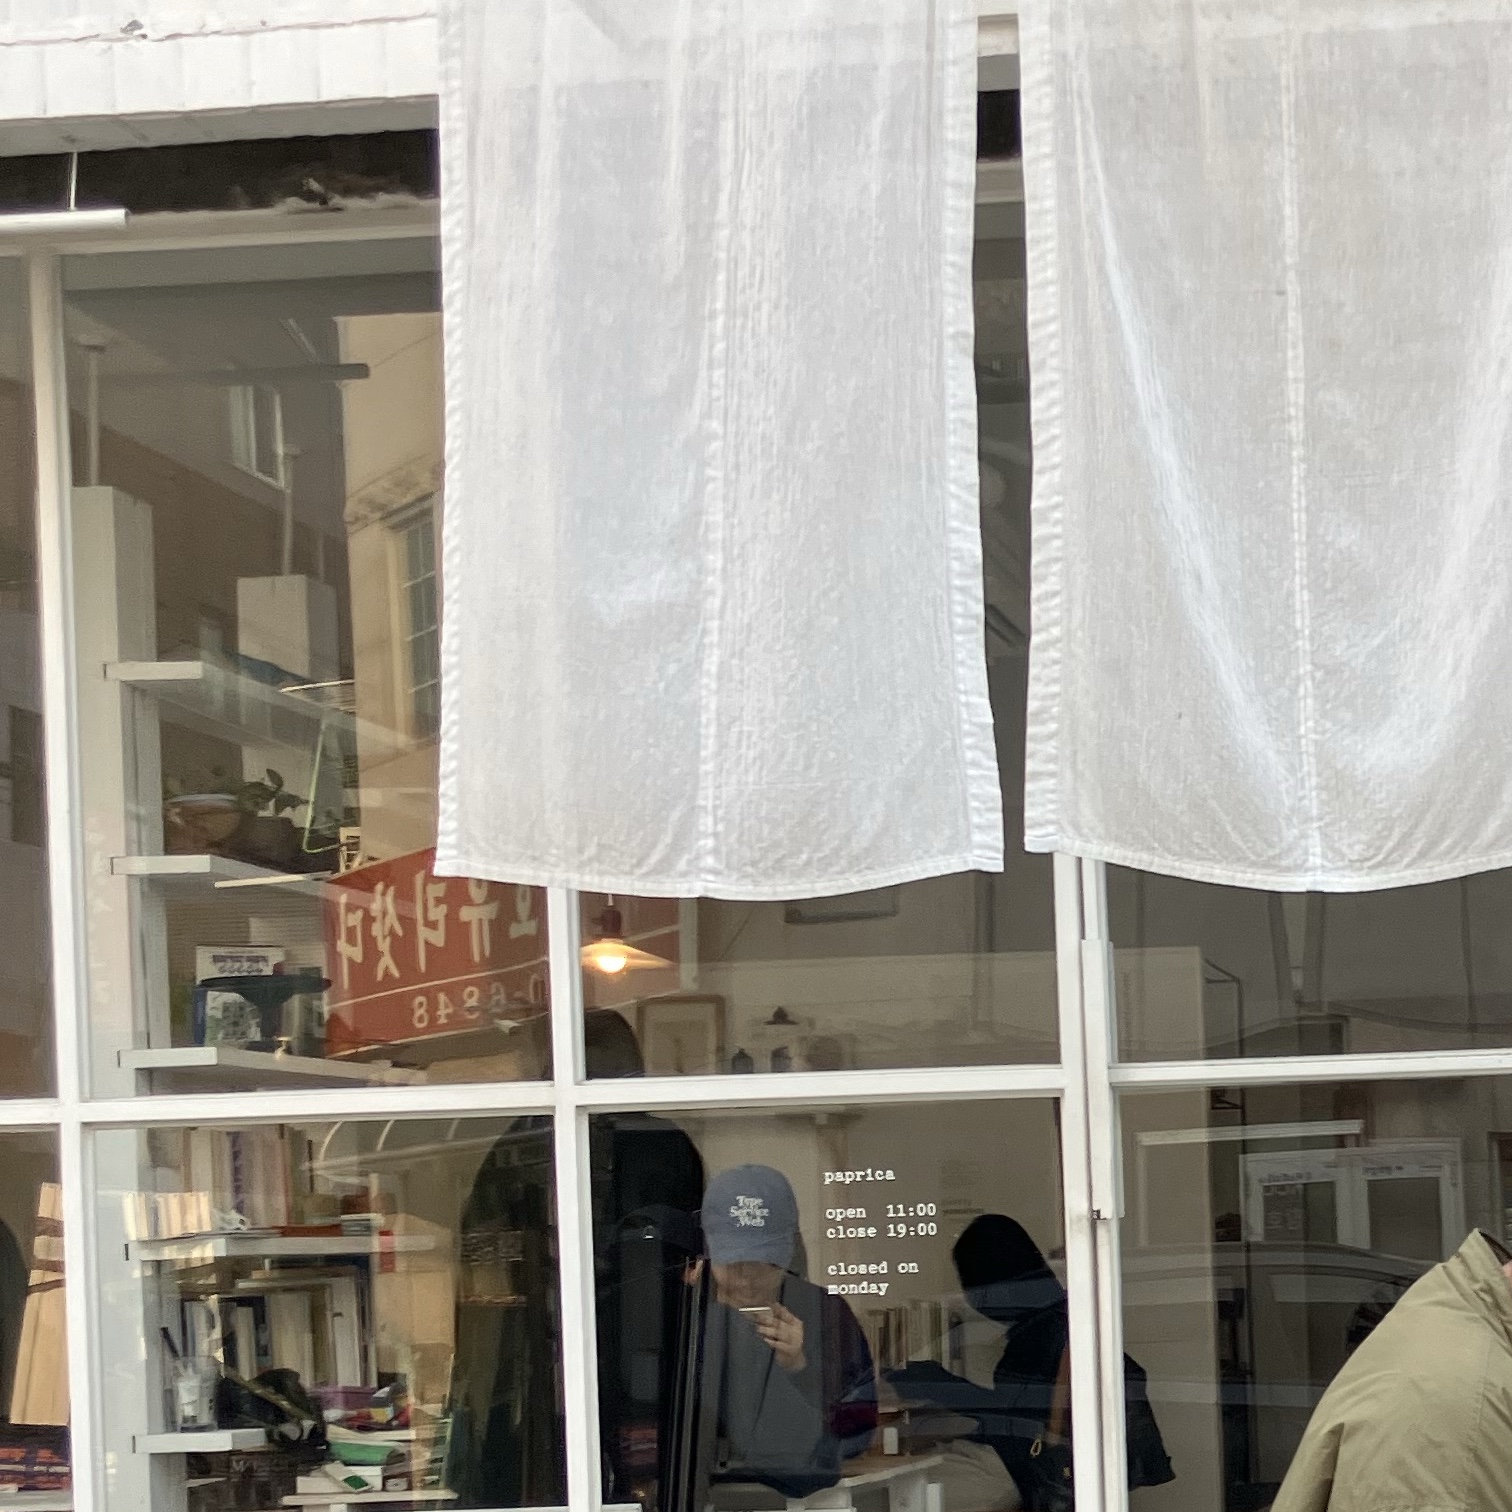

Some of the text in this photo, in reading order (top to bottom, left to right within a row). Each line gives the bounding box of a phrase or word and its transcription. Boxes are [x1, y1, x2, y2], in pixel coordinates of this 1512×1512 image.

[824, 1168, 895, 1185] paprica
[825, 1207, 867, 1222] open
[886, 1203, 937, 1217] 11:00
[826, 1222, 938, 1239] close 19:00
[827, 1261, 919, 1276] closed on
[827, 1281, 889, 1296] monday
